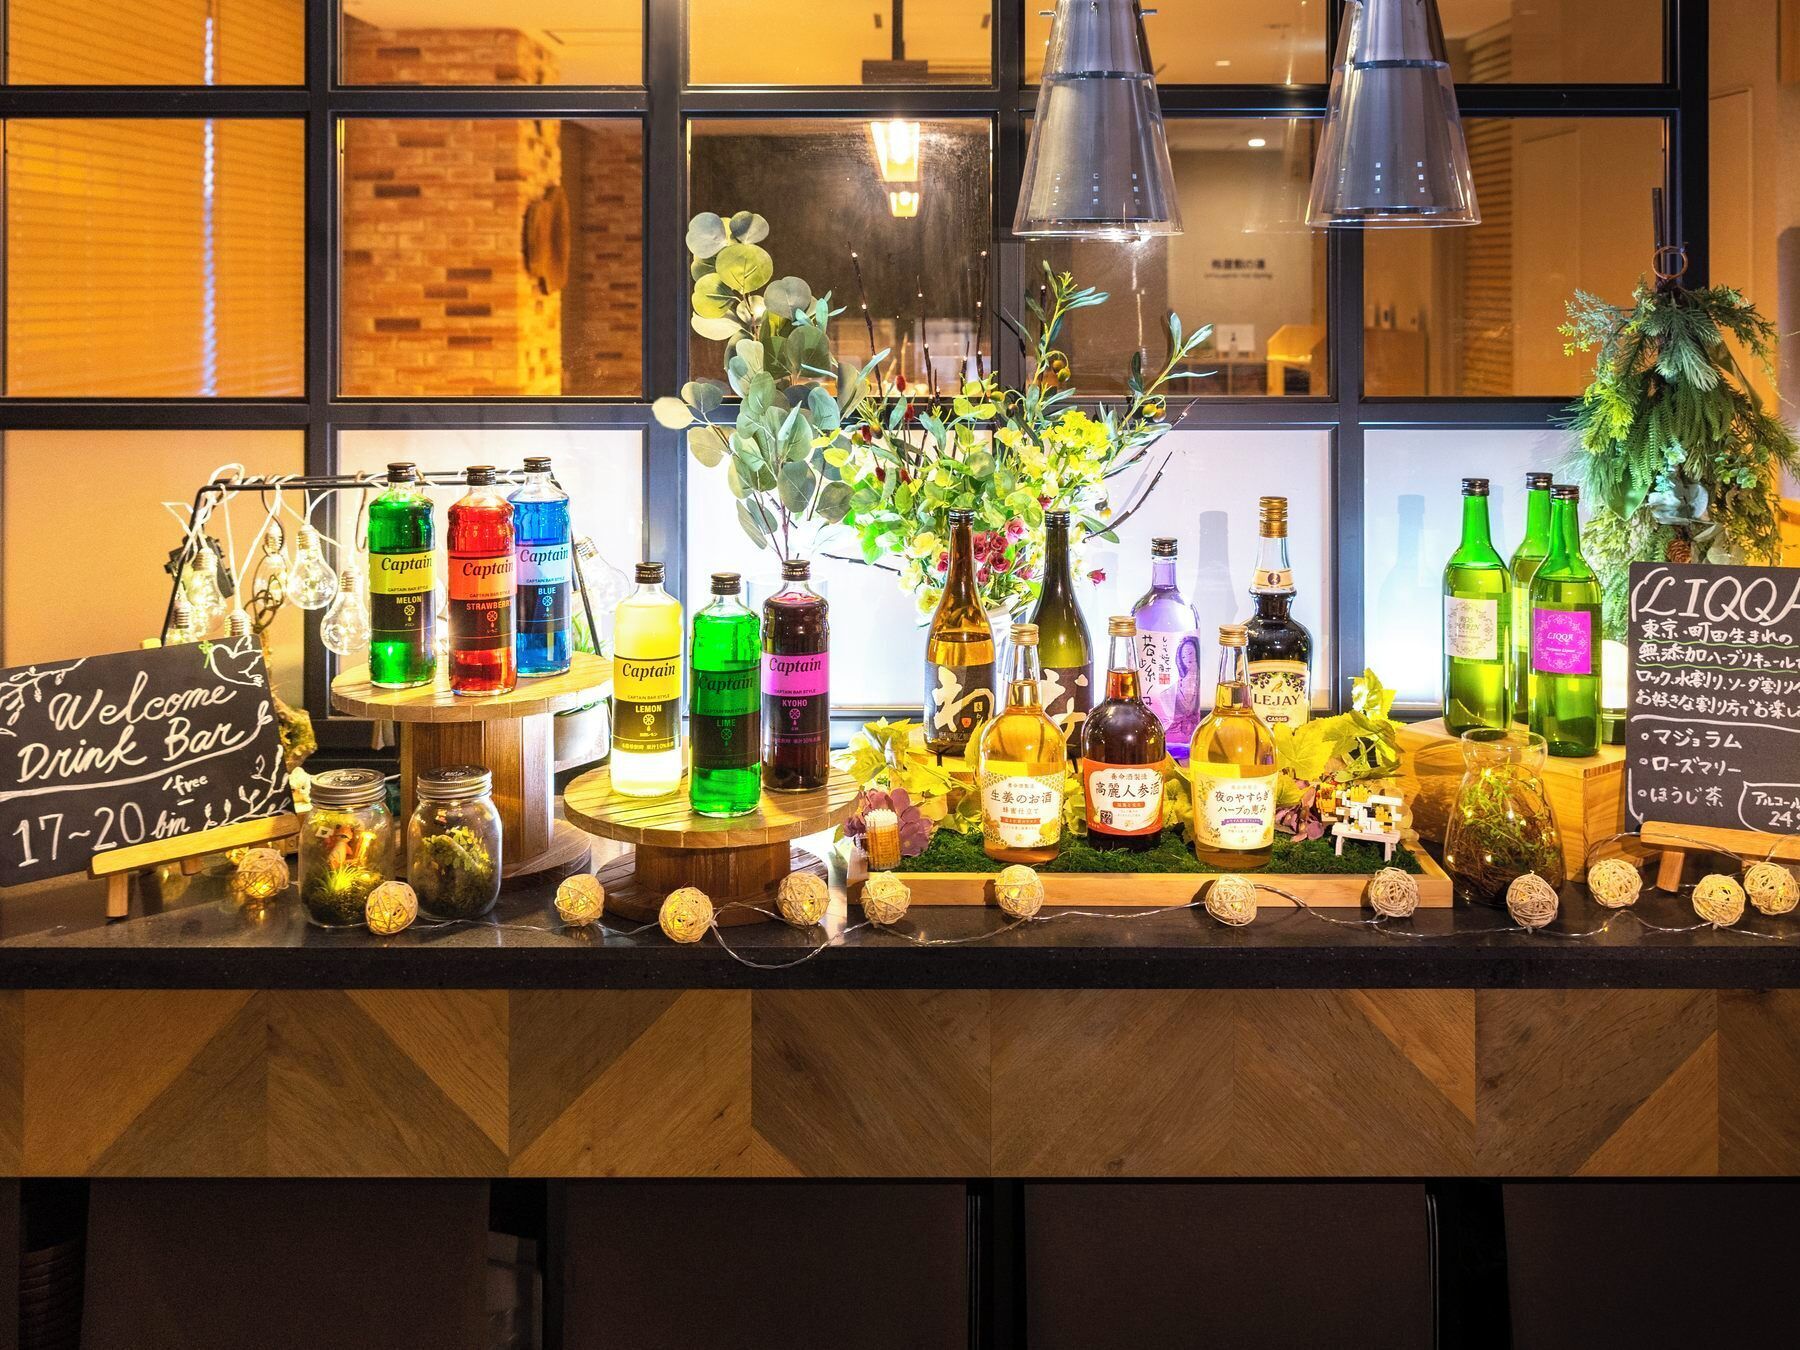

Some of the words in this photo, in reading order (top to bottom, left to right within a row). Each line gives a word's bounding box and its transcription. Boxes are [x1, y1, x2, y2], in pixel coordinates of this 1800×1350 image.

[381, 555, 432, 574] Captain
[520, 547, 568, 565] Captain
[462, 560, 513, 579] Captain
[396, 596, 422, 604] MELON
[538, 587, 556, 595] BLUE
[622, 662, 675, 681] Captain
[769, 657, 822, 676] Captain
[698, 675, 753, 694] Captain
[49, 671, 237, 730] Welcome
[635, 704, 662, 713] LEMON
[782, 699, 808, 707] KYOHO
[1254, 694, 1300, 706] LEJAY
[717, 719, 736, 727] LIME
[1652, 728, 1743, 749] マジョラム
[17, 725, 148, 783] Drink
[163, 717, 244, 762] Bar
[1651, 756, 1742, 776] ローズマリー
[172, 774, 208, 796] free
[1095, 781, 1160, 798] 高麗人参酒
[990, 789, 1053, 804] 生姜のお酒
[1215, 790, 1270, 803] 夜のやすらぎ
[1650, 786, 1724, 808] ほうじ茶
[1751, 791, 1800, 810] アルコール
[1217, 804, 1267, 815] ハーブの恵み
